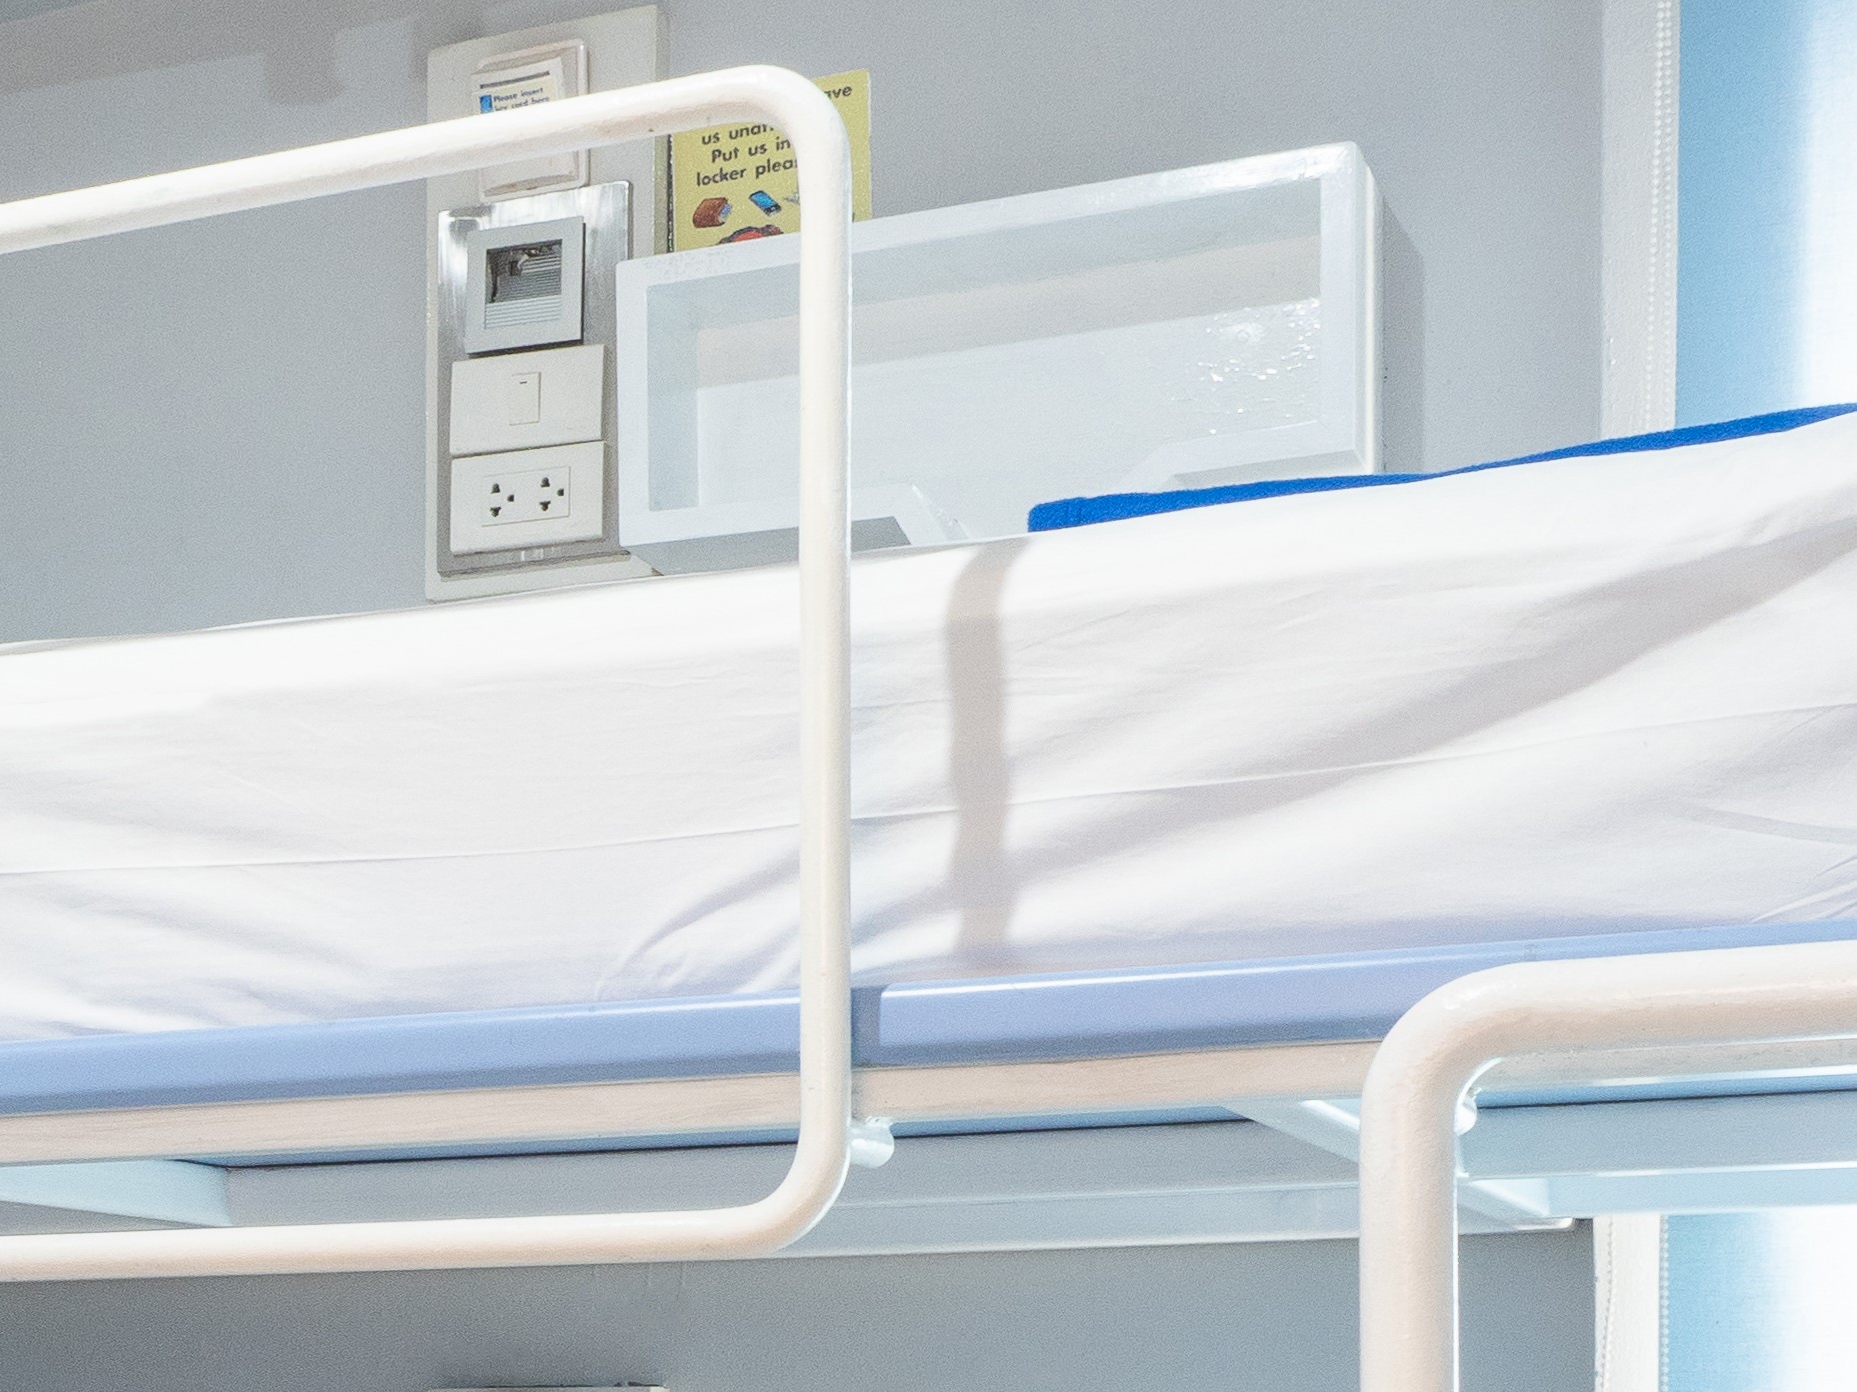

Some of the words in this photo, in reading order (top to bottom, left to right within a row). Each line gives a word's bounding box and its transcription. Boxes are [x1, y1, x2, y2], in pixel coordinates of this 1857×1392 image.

[494, 93, 518, 102] Please
[521, 88, 543, 97] insert
[511, 100, 529, 109] card
[701, 132, 720, 145] us
[711, 147, 740, 163] Put
[748, 143, 768, 157] us
[776, 136, 791, 151] in
[696, 167, 747, 187] locker
[755, 159, 798, 179] plea
